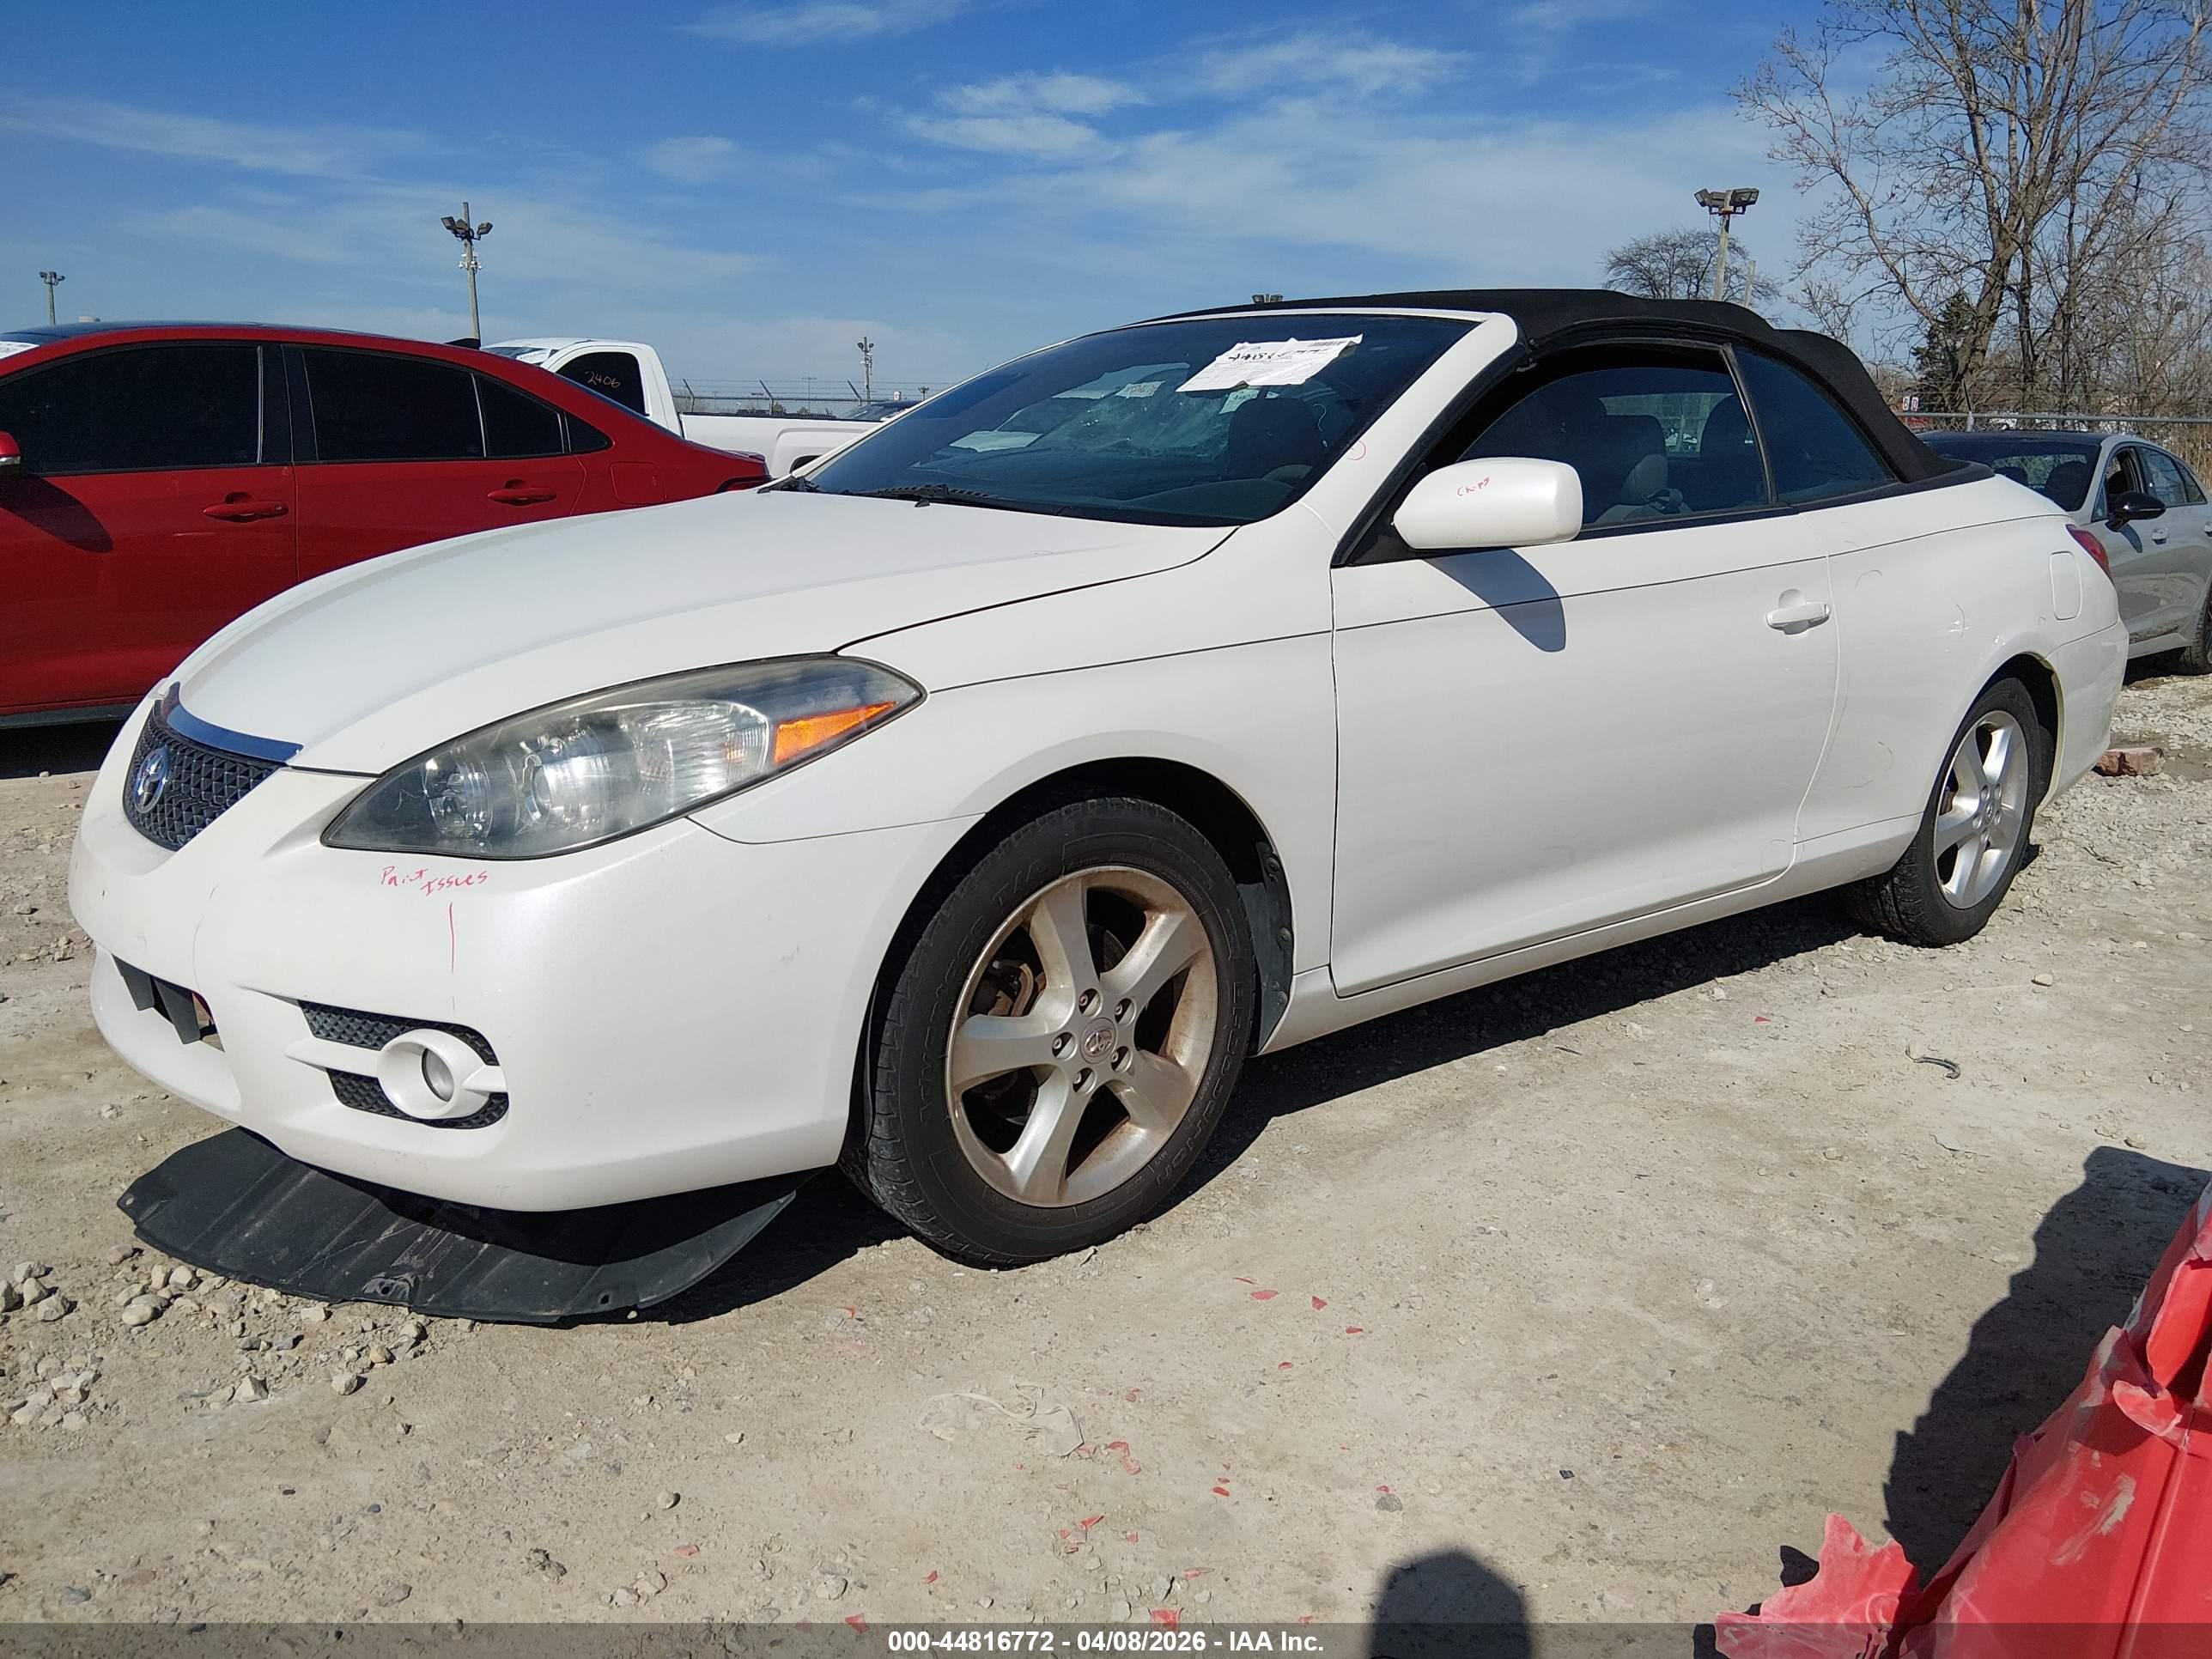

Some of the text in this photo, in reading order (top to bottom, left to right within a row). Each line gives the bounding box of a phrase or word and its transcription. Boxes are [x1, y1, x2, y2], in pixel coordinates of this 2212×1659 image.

[585, 370, 621, 388] 2406
[380, 866, 488, 896] Paint Issues
